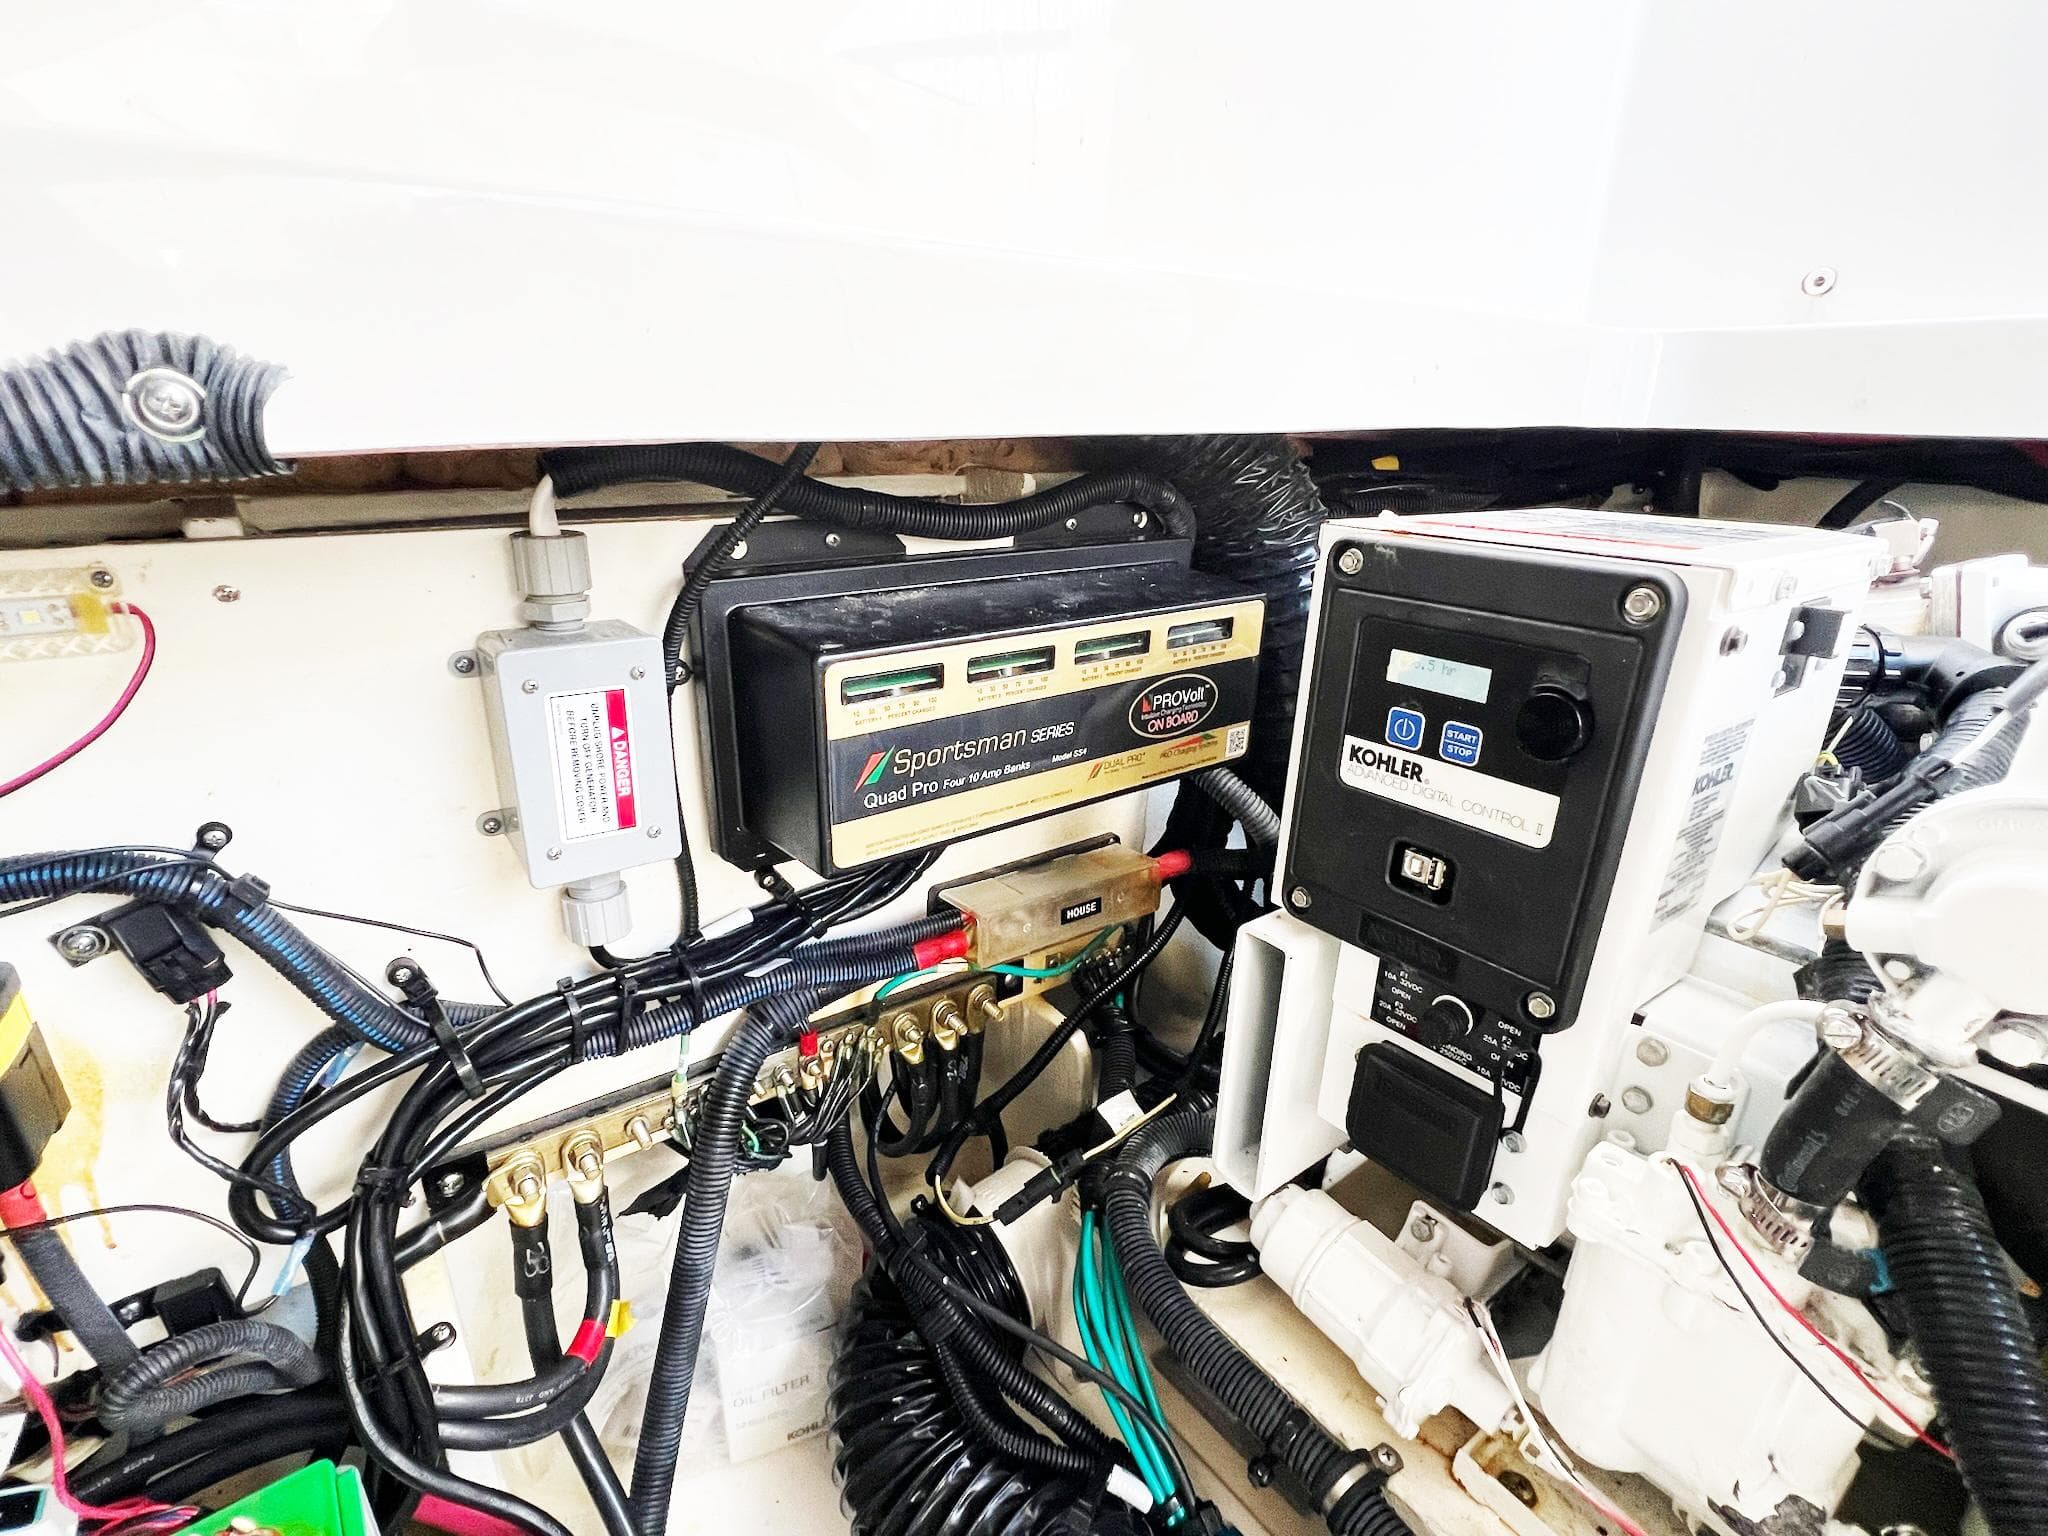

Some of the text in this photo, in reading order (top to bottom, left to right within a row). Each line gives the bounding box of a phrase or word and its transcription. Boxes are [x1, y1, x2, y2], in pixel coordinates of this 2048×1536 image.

[1152, 686, 1205, 710] PROVolt
[1147, 710, 1199, 733] ON BOARD
[1446, 730, 1478, 744] START
[893, 722, 1075, 778] Sportsman SERIES
[1052, 750, 1074, 763] Model
[1447, 745, 1473, 758] STOP
[566, 710, 588, 824] BEFORE REMOVING COVER
[580, 717, 598, 814] TURN OFF GENERATOR
[590, 703, 612, 824] UNPLUG SHORE POWER AND
[612, 741, 632, 797] DANGER
[1103, 758, 1124, 770] DUAL
[864, 760, 1031, 809] Quad Pro Four 10 Amp Banks
[1347, 764, 1544, 836] ADVANCED DIGITAL CONTROL II
[1066, 901, 1097, 920] HOUSE
[1384, 970, 1423, 994] 10A 32VDC
[1400, 970, 1408, 979] F1
[1391, 986, 1412, 1001] OPEN
[1379, 1000, 1418, 1024] 20A 32VDC
[1386, 1016, 1406, 1030] OPEN
[1498, 1020, 1522, 1036] OPEN
[1482, 1034, 1498, 1047] 25A
[1502, 1036, 1512, 1046] F2
[1476, 1066, 1491, 1078] 10A
[733, 1395, 755, 1408] OIL
[762, 1374, 809, 1400] FILTER
